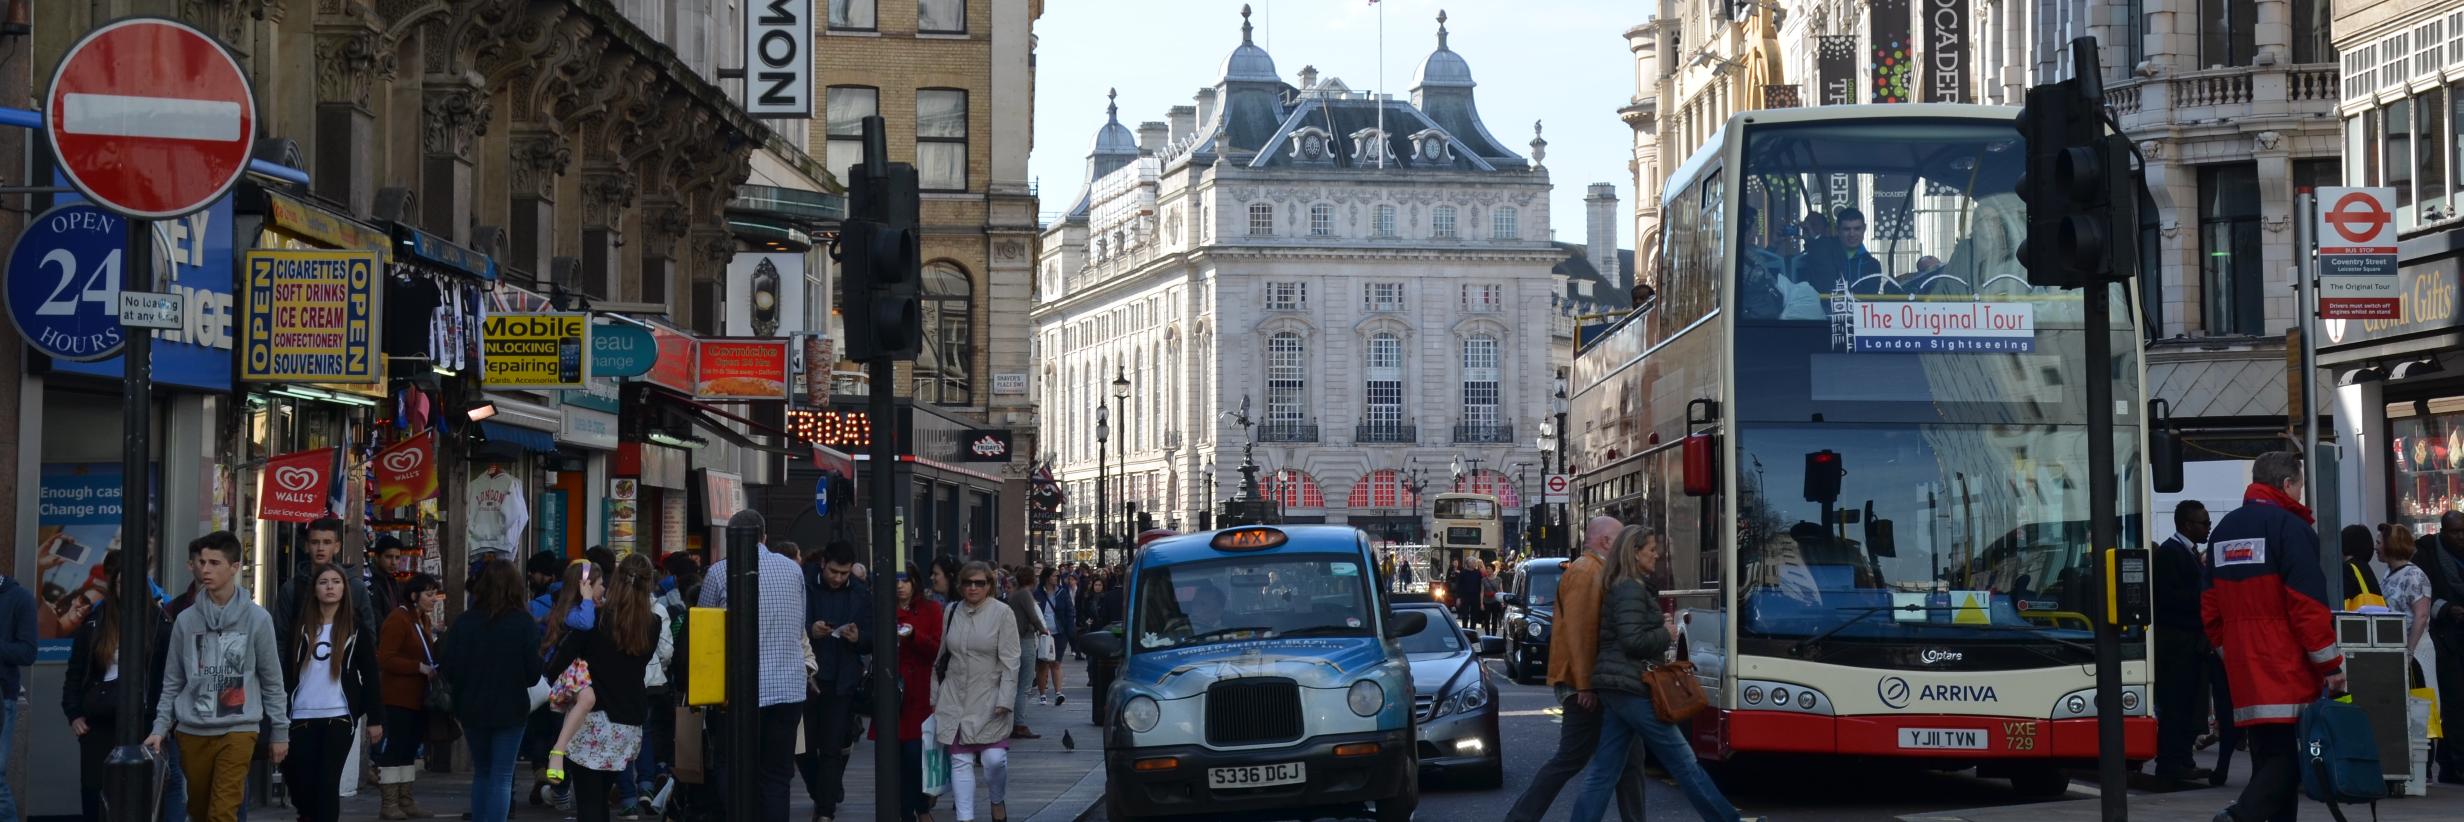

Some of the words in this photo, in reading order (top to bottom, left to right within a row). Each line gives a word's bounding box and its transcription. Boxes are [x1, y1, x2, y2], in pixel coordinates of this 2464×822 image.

[51, 211, 115, 235] OPEN
[276, 259, 346, 280] CIGARETTES
[2331, 258, 2364, 266] Coventry
[35, 248, 122, 316] 24
[2345, 283, 2373, 291] Original
[275, 283, 303, 302] SOFT
[306, 284, 345, 303] DRINKS
[2414, 270, 2452, 323] Gifts
[125, 296, 139, 307] No
[124, 310, 134, 320] at
[137, 312, 154, 323] any
[252, 261, 271, 371] OPEN
[275, 306, 296, 328] ICE
[300, 306, 344, 329] CREAM
[349, 262, 368, 372] OPEN
[1861, 304, 1892, 329] The
[1901, 304, 1977, 335] Original
[1984, 305, 2024, 330] Tour
[482, 317, 581, 337] Mobile
[40, 326, 120, 355] HOURS
[274, 333, 344, 348] CONFECTIONERY
[485, 342, 555, 353] NLOCKING
[1865, 339, 1922, 349] London
[1930, 339, 2028, 351] Sightseeing
[274, 354, 342, 375] SOUVENIRS
[40, 485, 93, 501] Enough
[275, 491, 314, 503] WALL'S
[476, 487, 505, 506] LONDON
[39, 503, 94, 518] Change
[1228, 529, 1269, 545] TAXI
[1928, 650, 1963, 662] Optare
[1920, 685, 1998, 702] ARRIVA
[2002, 720, 2037, 736] VXE
[1911, 731, 1940, 746] YJ11
[1945, 731, 1976, 747] TVN
[2005, 737, 2034, 750] 729
[1215, 767, 1260, 784] S336
[1265, 763, 1299, 782] DGJ
